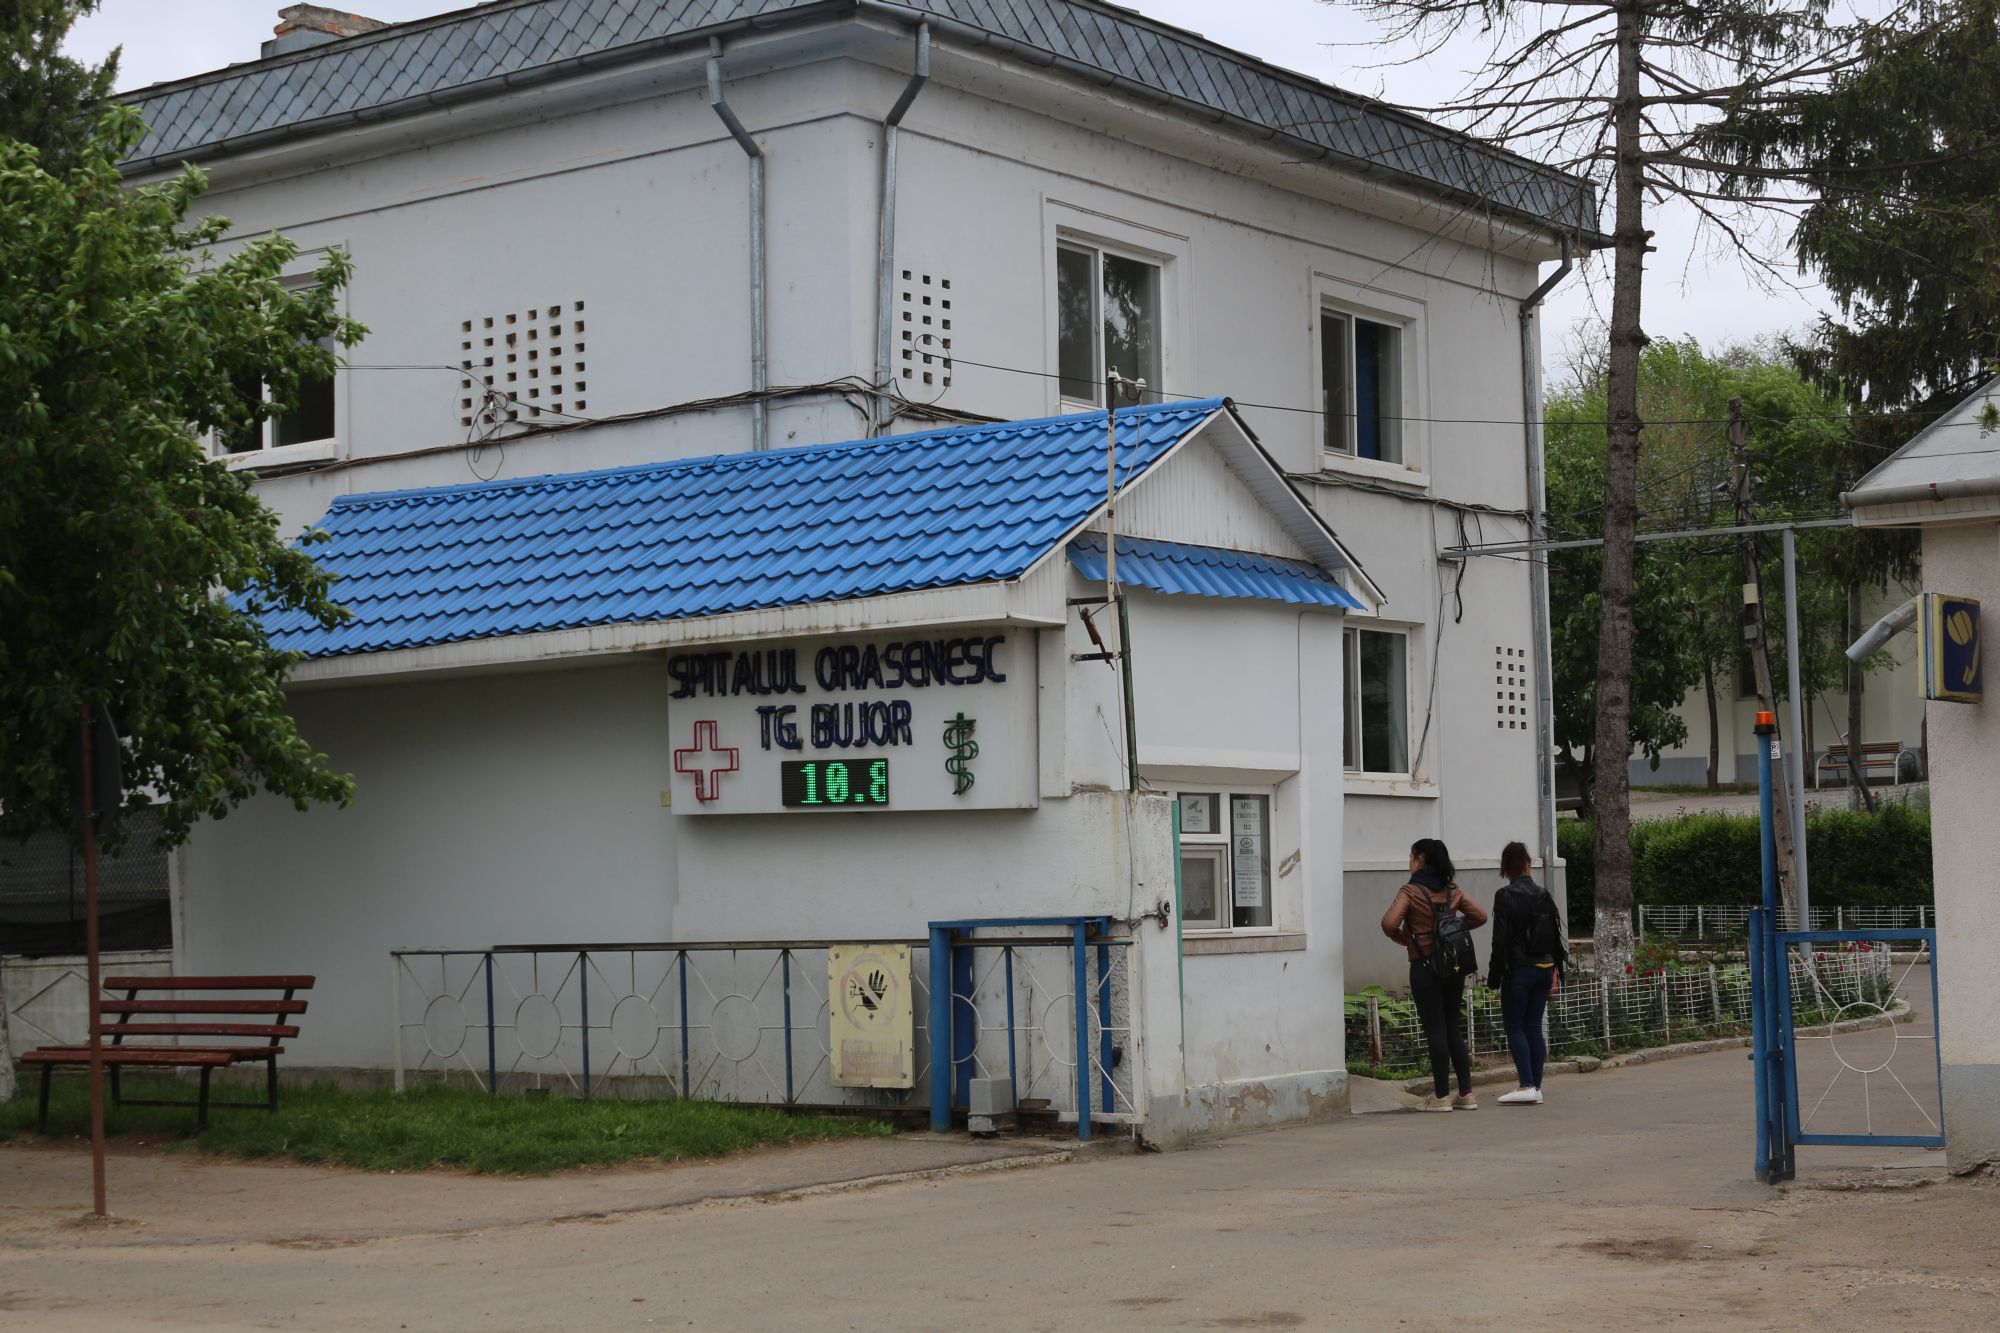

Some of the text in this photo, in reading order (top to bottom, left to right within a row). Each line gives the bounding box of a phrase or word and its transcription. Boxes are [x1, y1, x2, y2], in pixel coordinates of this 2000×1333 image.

[668, 635, 1007, 699] SPITALUL ORASENESC
[810, 700, 913, 749] BUJOR
